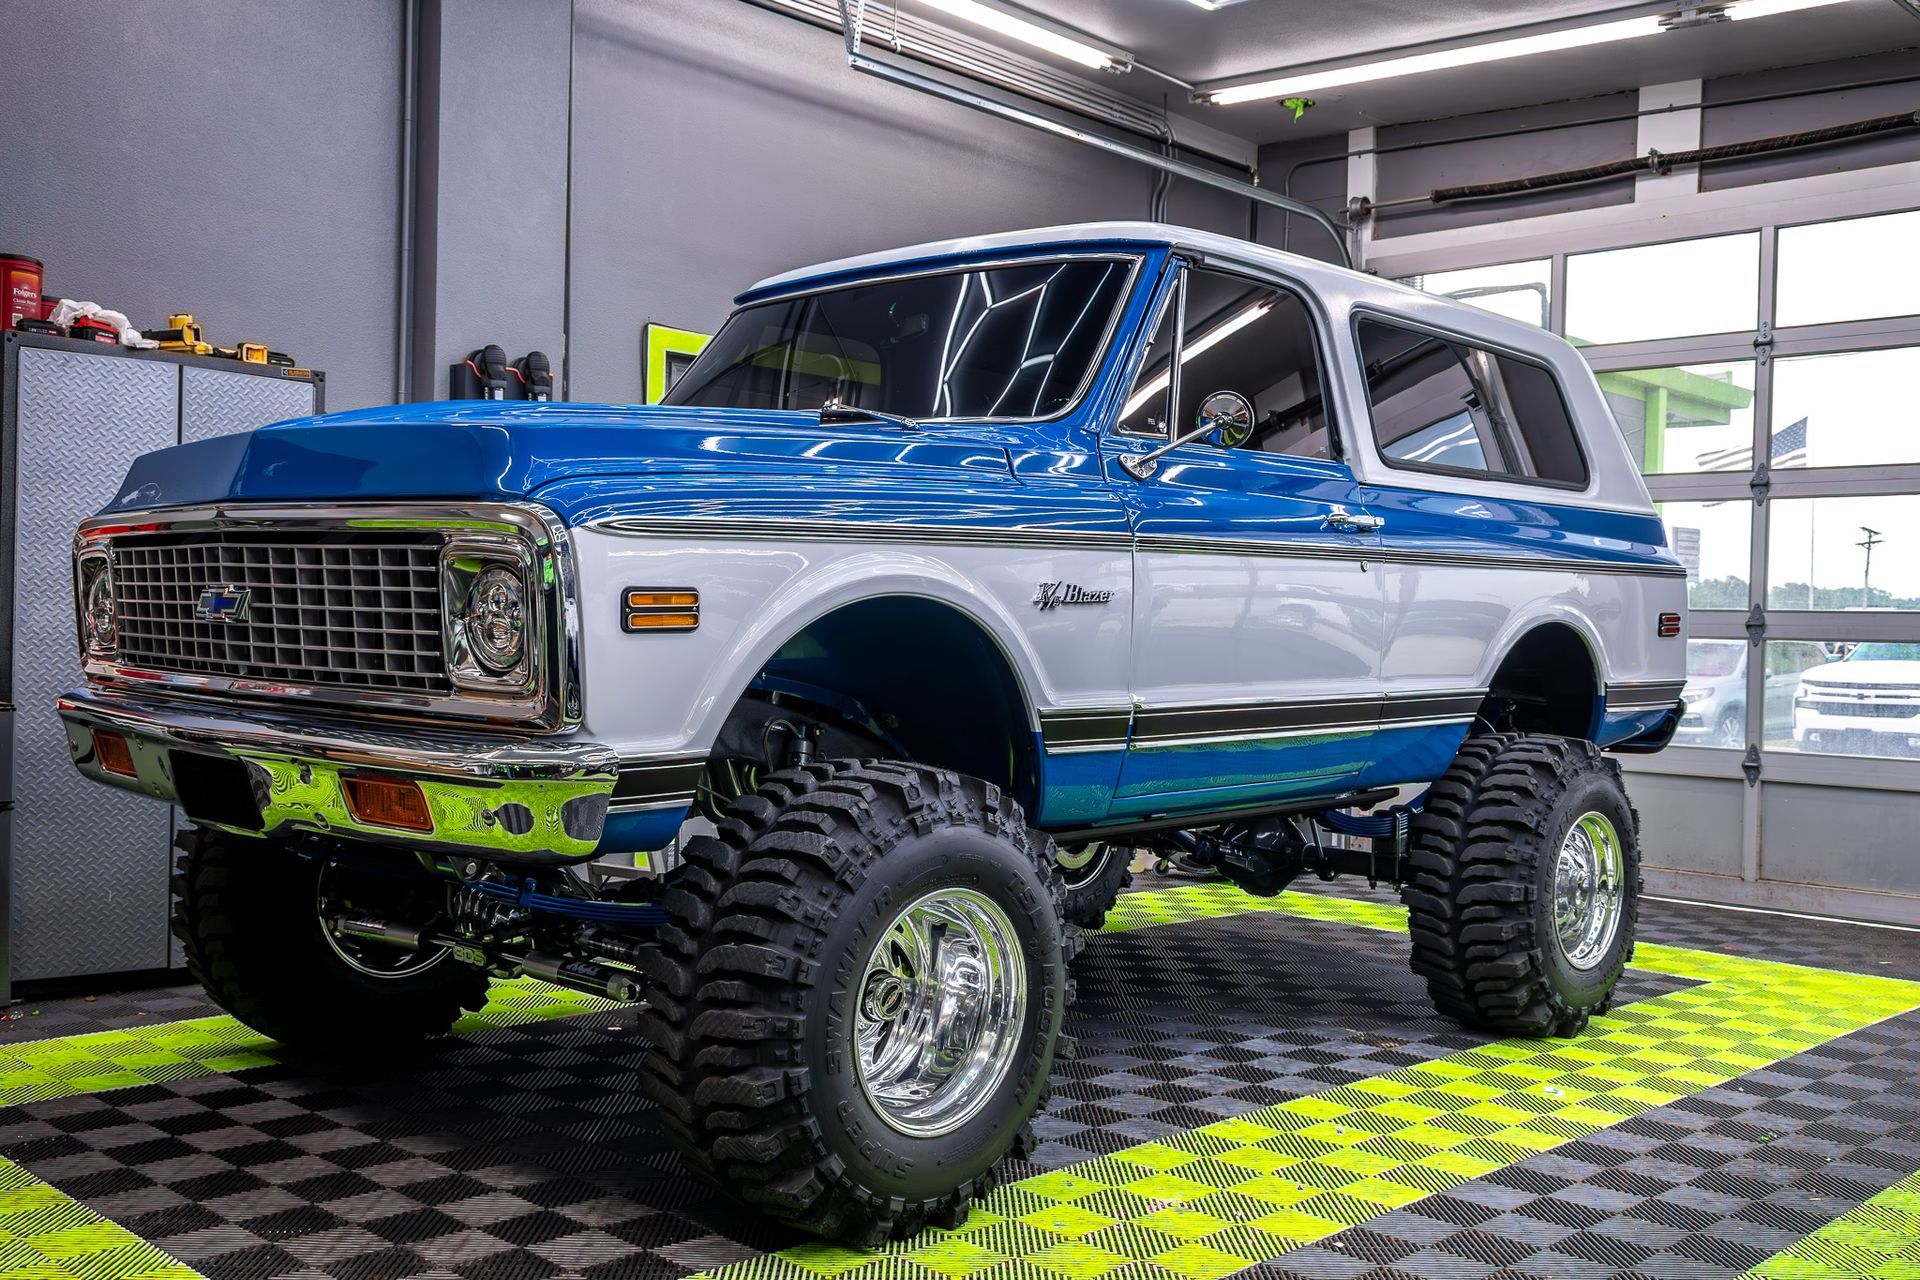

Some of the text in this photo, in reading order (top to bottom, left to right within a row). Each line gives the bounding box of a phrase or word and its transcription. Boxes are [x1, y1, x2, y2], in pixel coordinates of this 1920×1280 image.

[13, 287, 37, 298] Folgers
[1064, 583, 1115, 604] Blazer
[826, 886, 916, 1179] SUPER SWAMPER
